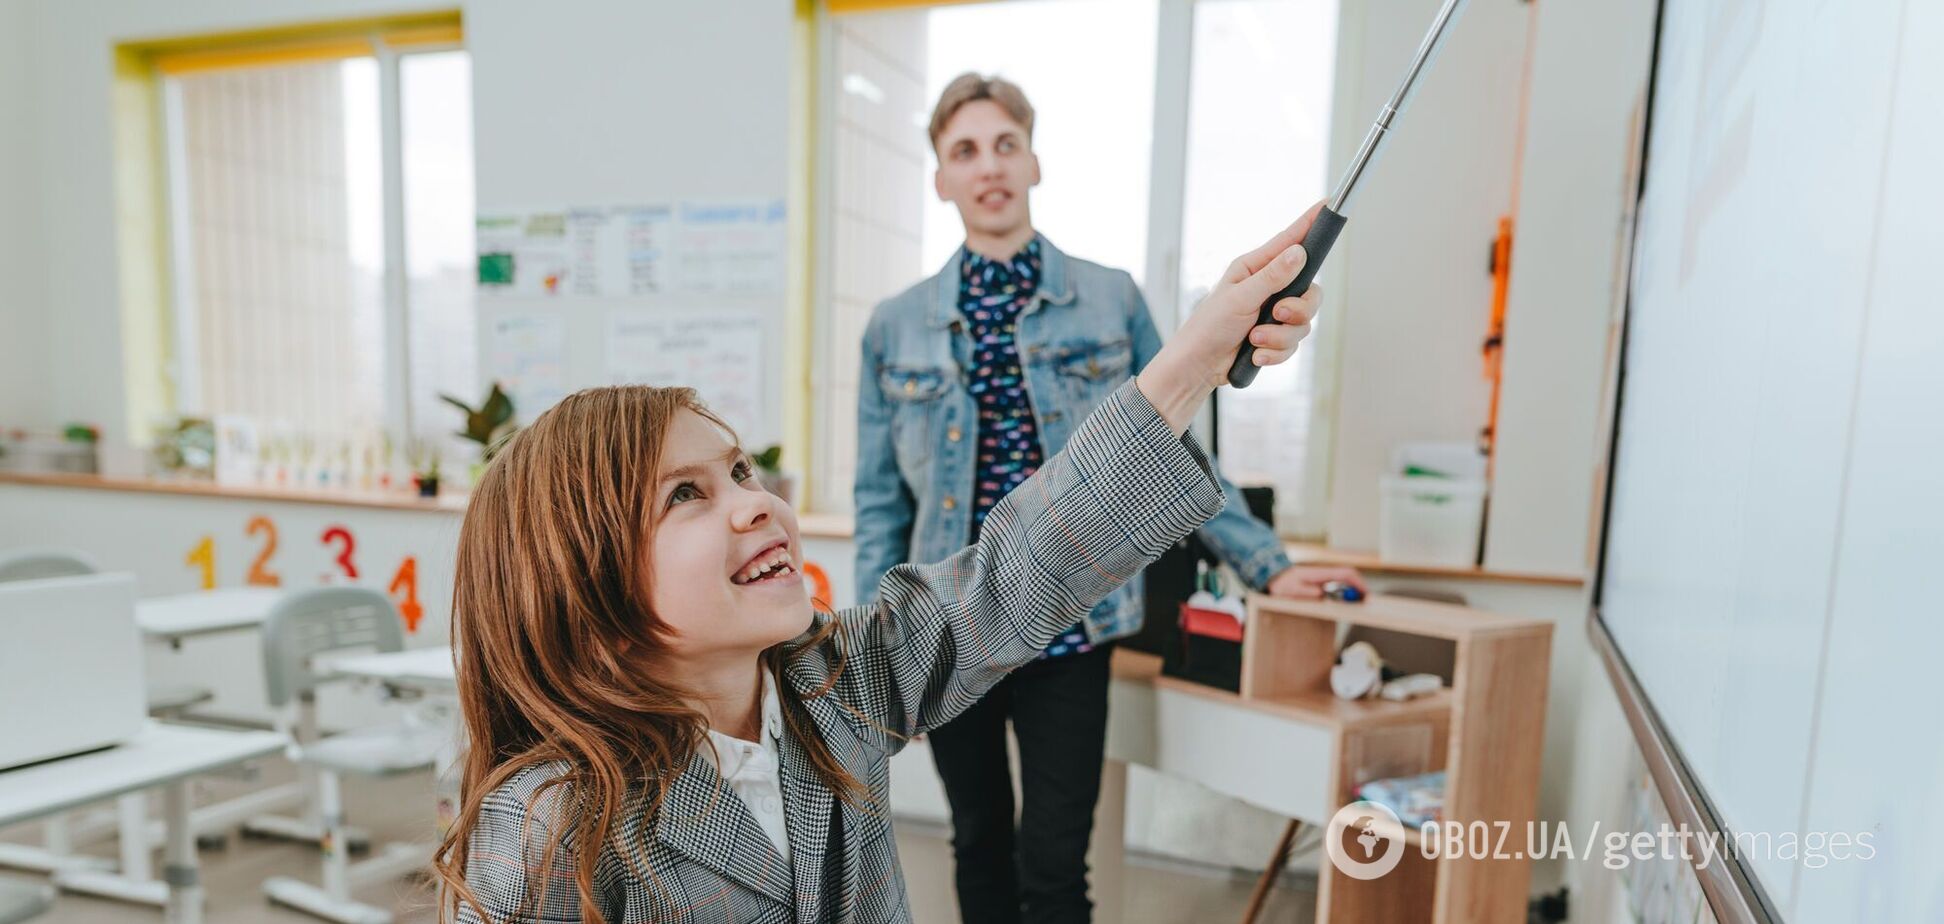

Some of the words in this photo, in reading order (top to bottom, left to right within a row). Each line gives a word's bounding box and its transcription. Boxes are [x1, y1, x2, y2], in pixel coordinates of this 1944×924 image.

[186, 535, 216, 590] 1
[245, 515, 281, 587] 2
[319, 526, 359, 581] 3
